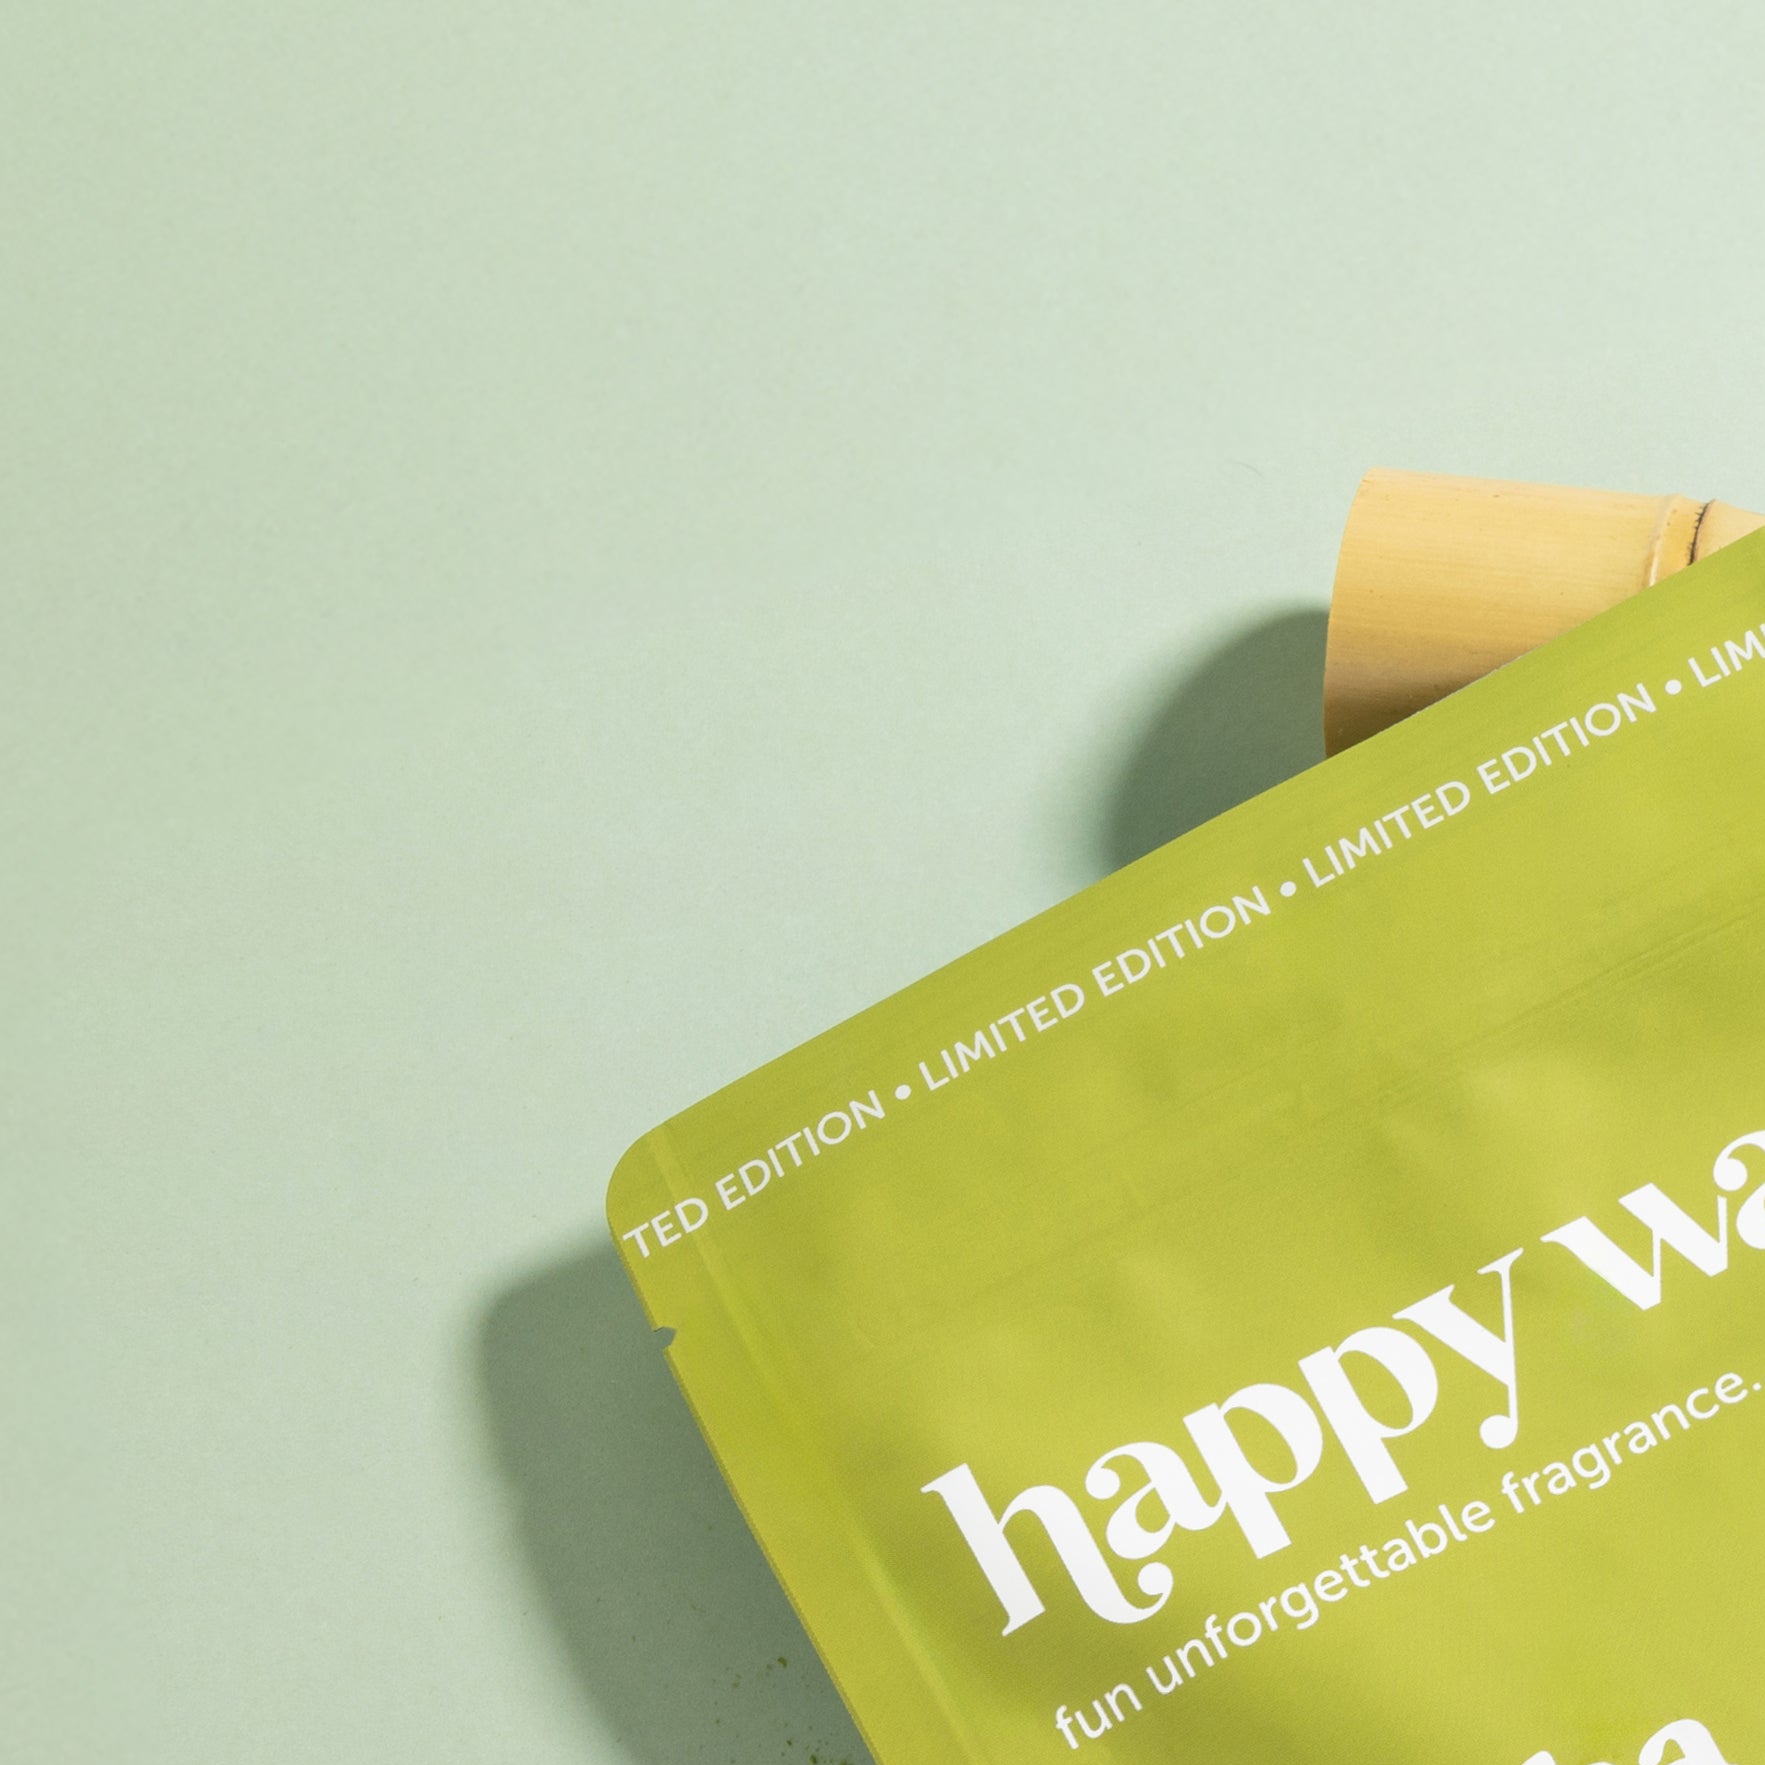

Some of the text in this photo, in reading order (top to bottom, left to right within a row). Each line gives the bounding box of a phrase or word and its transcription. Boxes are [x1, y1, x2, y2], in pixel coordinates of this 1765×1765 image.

[622, 1197, 709, 1258] TED
[715, 1090, 885, 1210] EDITION
[918, 983, 1085, 1091] LIMITED
[1092, 885, 1271, 997] EDITION
[1302, 780, 1471, 887] LIMITED
[1476, 683, 1657, 795] EDITION
[921, 1247, 1524, 1636] happy
[1055, 1684, 1142, 1750] fun
[1146, 1500, 1496, 1694] unforgettable
